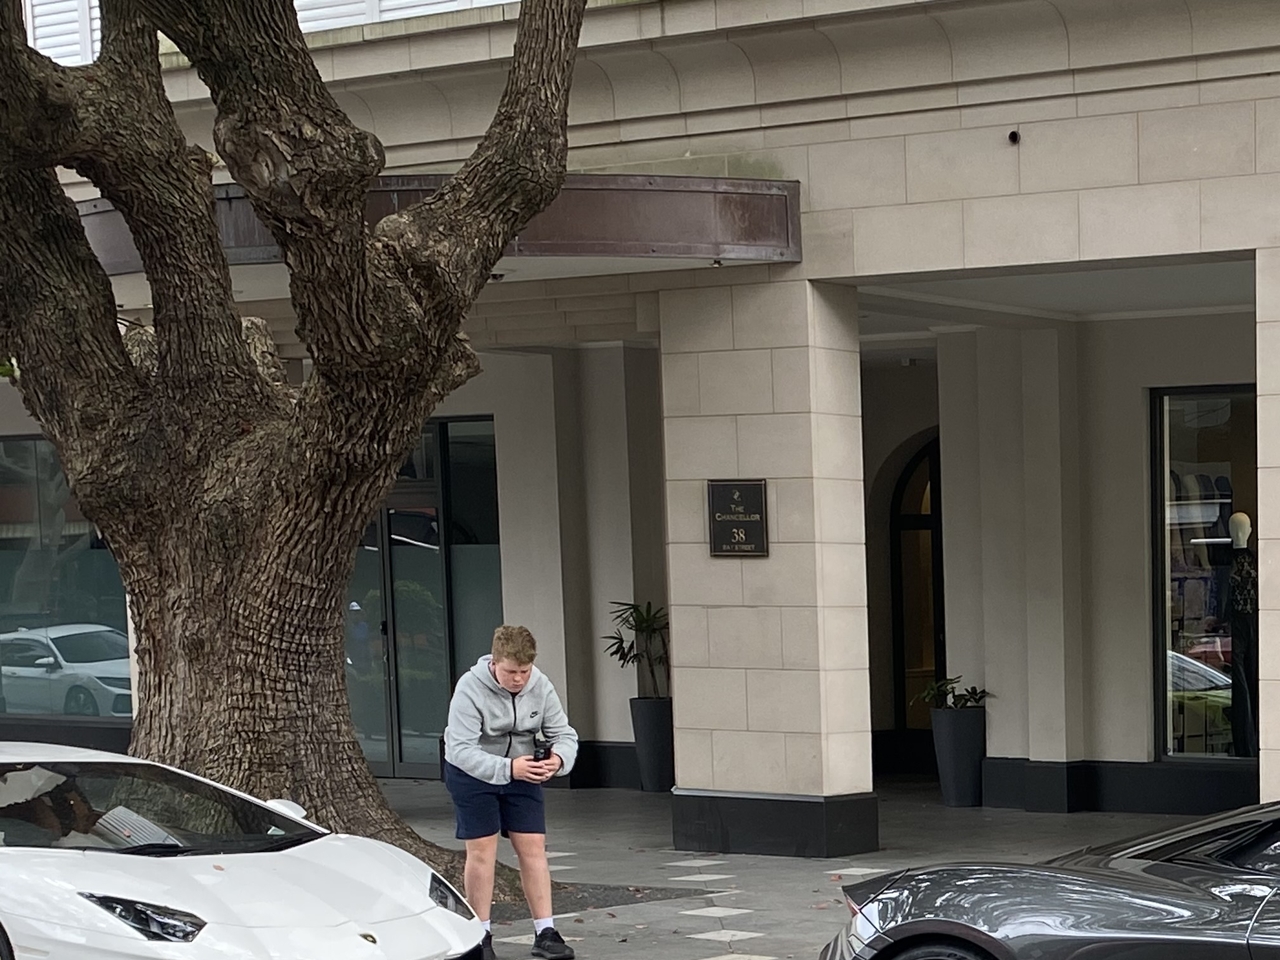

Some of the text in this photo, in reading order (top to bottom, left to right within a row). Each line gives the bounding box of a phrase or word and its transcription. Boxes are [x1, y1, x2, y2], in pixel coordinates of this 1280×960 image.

[730, 504, 745, 513] THE
[715, 512, 761, 521] CHANCELLOR
[731, 528, 746, 543] 38
